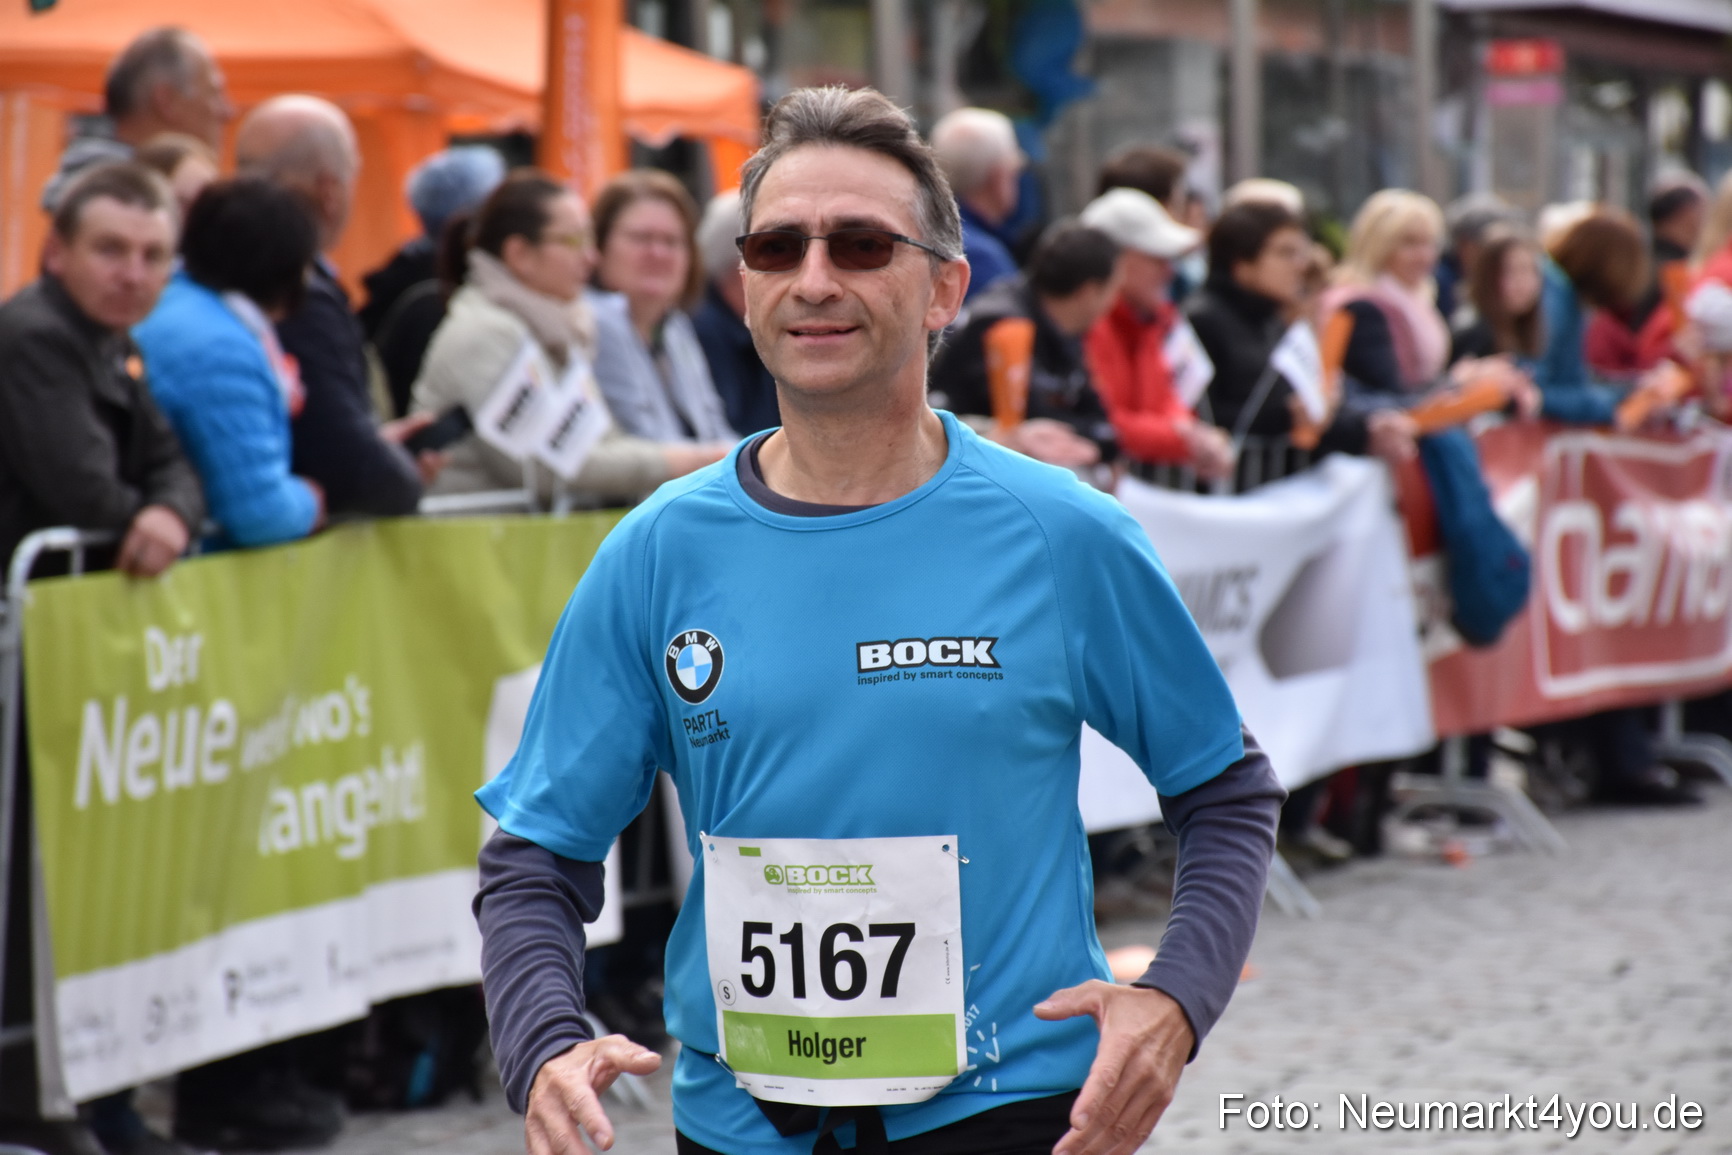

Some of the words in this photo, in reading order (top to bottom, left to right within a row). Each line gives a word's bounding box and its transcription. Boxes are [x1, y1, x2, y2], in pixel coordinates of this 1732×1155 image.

[145, 626, 202, 691] Der
[668, 632, 718, 660] BMW
[857, 638, 1000, 673] BOCK
[857, 671, 900, 685] inspired
[904, 671, 916, 681] by
[920, 670, 953, 679] smart
[956, 671, 1004, 682] concepts
[683, 709, 727, 736] PARTL
[689, 728, 731, 749] Neumarkt
[75, 696, 237, 810] Neue
[785, 865, 876, 885] BOCK
[787, 887, 812, 895] inspired
[813, 887, 822, 895] by
[846, 887, 878, 895] concepts
[740, 921, 916, 1001] 5167
[723, 985, 731, 1000] S
[787, 1029, 867, 1064] Holger
